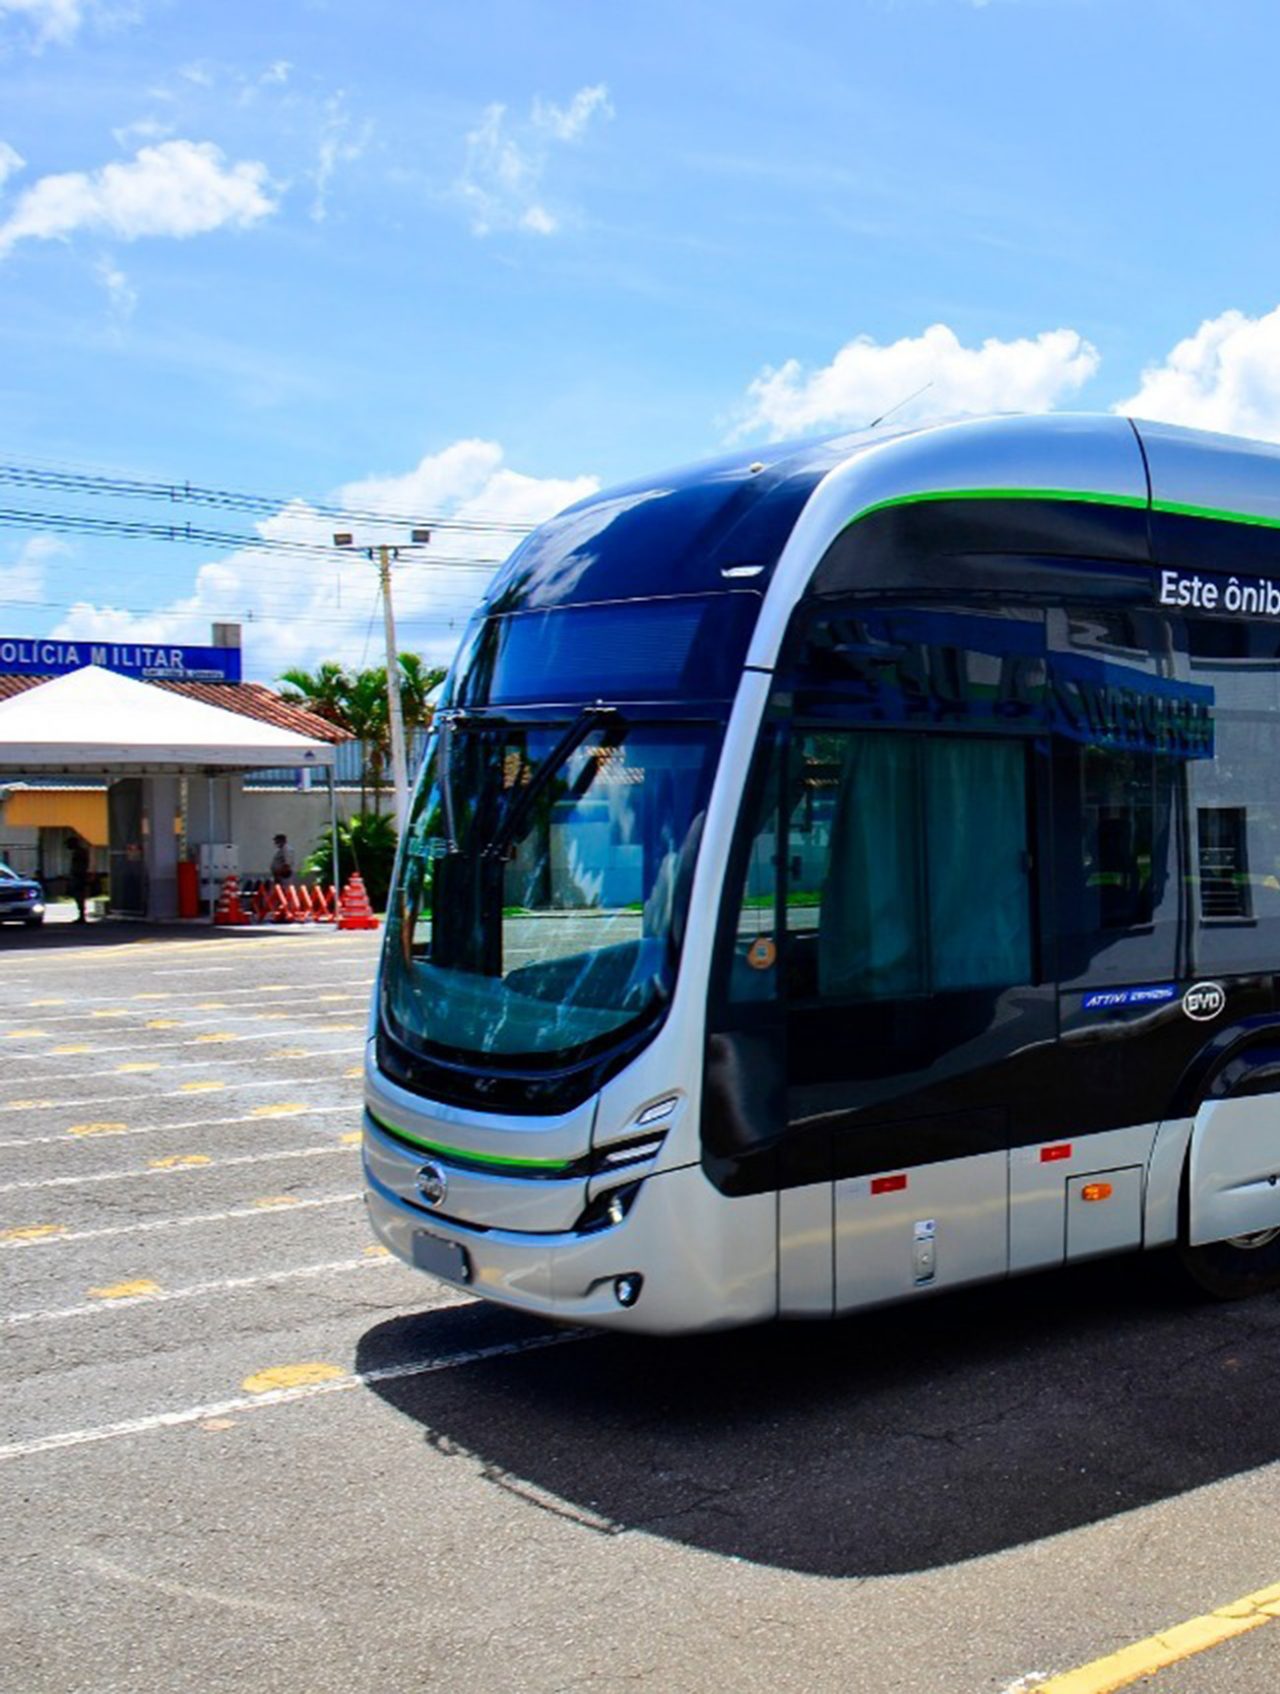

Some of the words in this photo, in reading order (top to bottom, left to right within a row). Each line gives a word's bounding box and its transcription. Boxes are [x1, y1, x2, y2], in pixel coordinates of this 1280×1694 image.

[1160, 570, 1218, 609] Este
[0, 640, 80, 665] OLÍCIA
[91, 647, 183, 668] MILITAR
